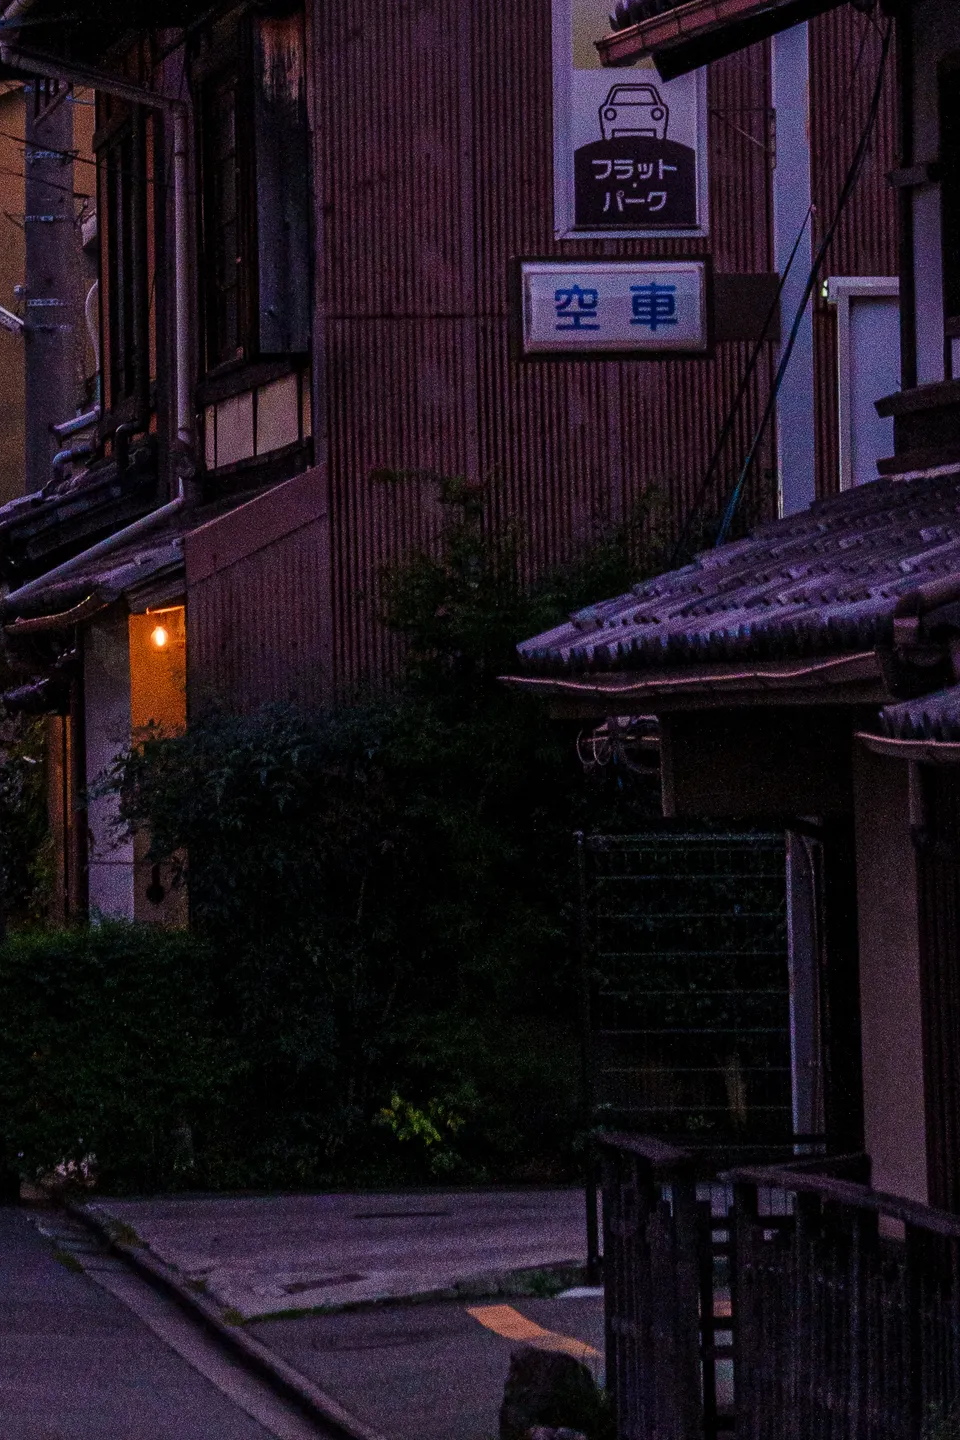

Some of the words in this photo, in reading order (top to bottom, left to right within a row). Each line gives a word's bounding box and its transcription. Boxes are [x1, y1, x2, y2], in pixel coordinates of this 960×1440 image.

[591, 159, 678, 180] フラット
[604, 190, 667, 212] パーク
[555, 282, 678, 331] 空車
